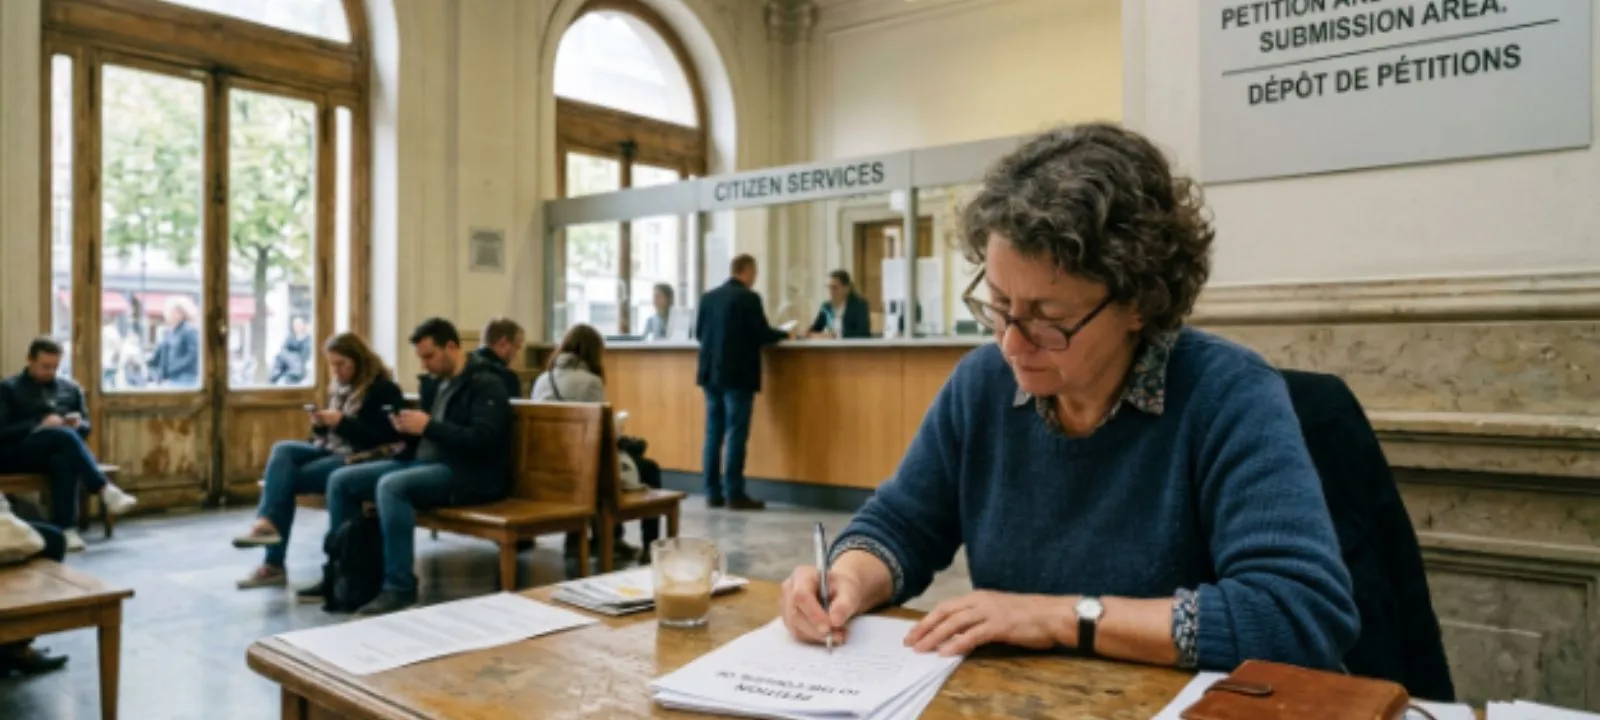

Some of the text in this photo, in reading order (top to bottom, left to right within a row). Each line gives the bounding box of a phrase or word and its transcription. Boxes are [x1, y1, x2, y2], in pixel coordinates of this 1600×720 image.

[1221, 0, 1326, 29] PETITION
[1260, 0, 1508, 53] SUBMISSION AREA.
[1248, 44, 1522, 105] DÉPÔT DE PÉTITIONS
[714, 161, 885, 201] CITIZEN SERVICES
